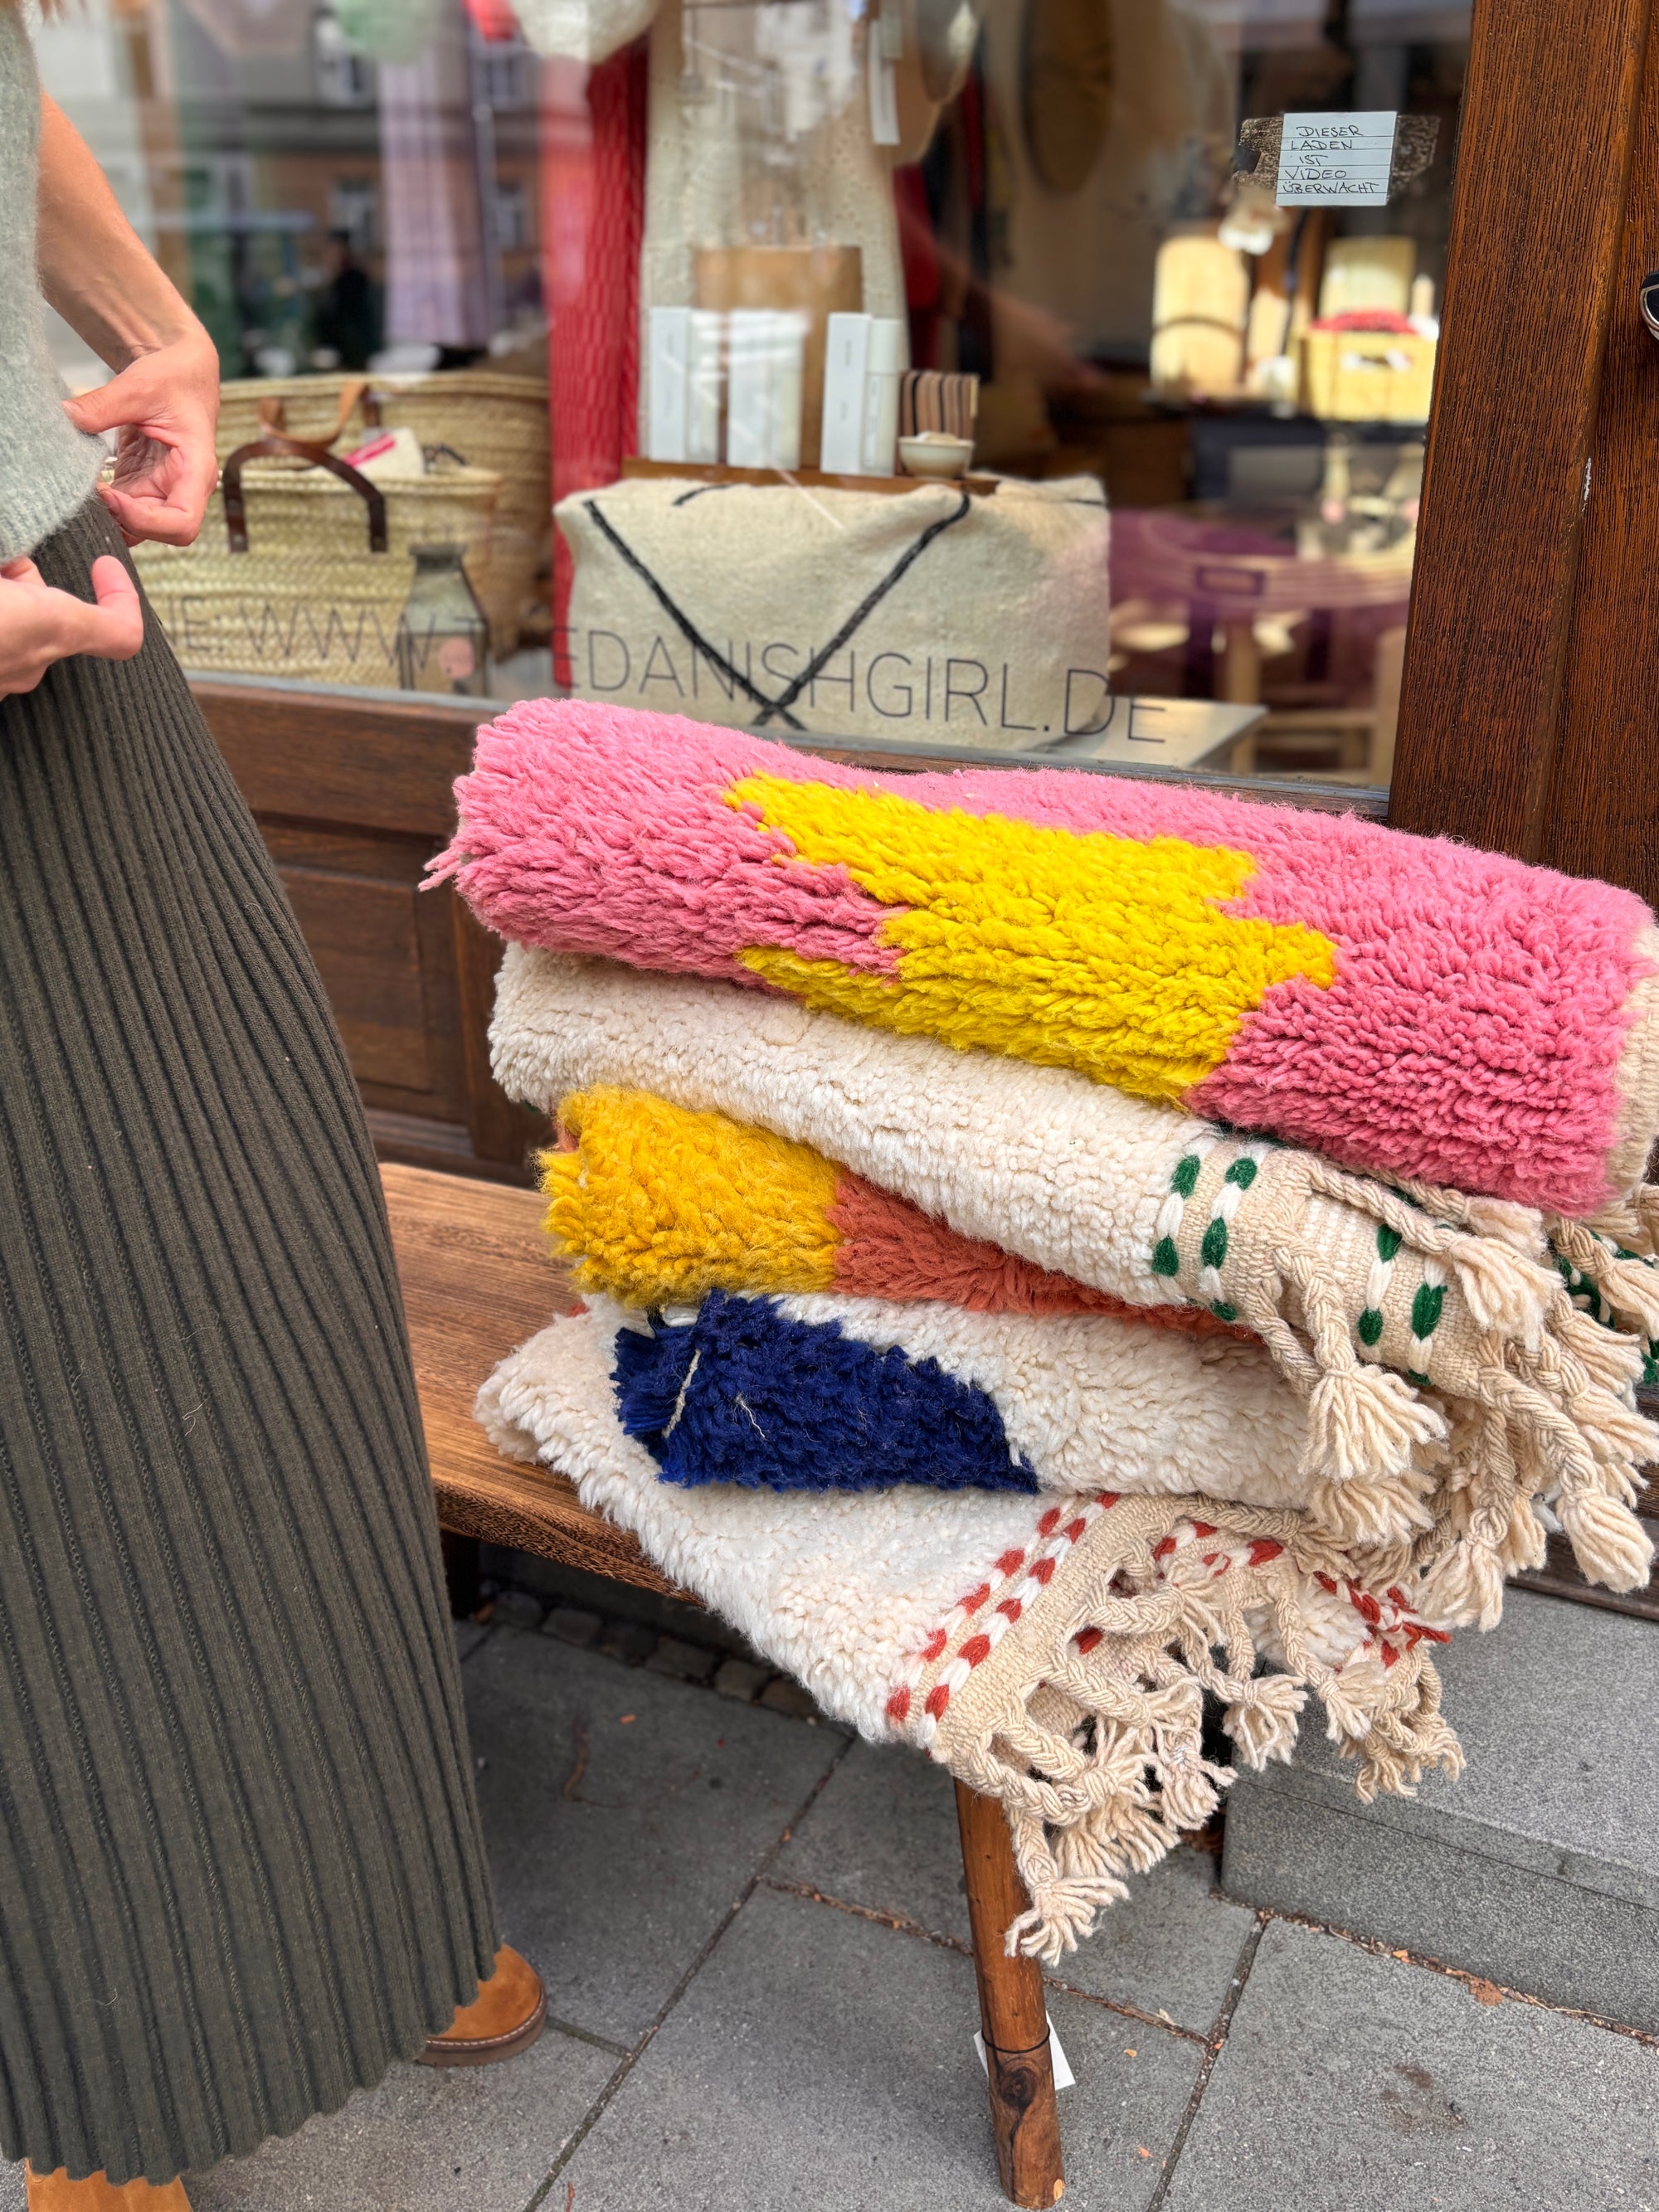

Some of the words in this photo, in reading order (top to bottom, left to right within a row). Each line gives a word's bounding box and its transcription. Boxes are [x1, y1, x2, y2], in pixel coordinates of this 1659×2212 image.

[1296, 124, 1364, 138] DIESER
[1291, 139, 1353, 150] LADEN
[1299, 154, 1328, 166] IST
[1284, 166, 1347, 180] VIDEO
[1282, 181, 1379, 194] ÜBERWACHT
